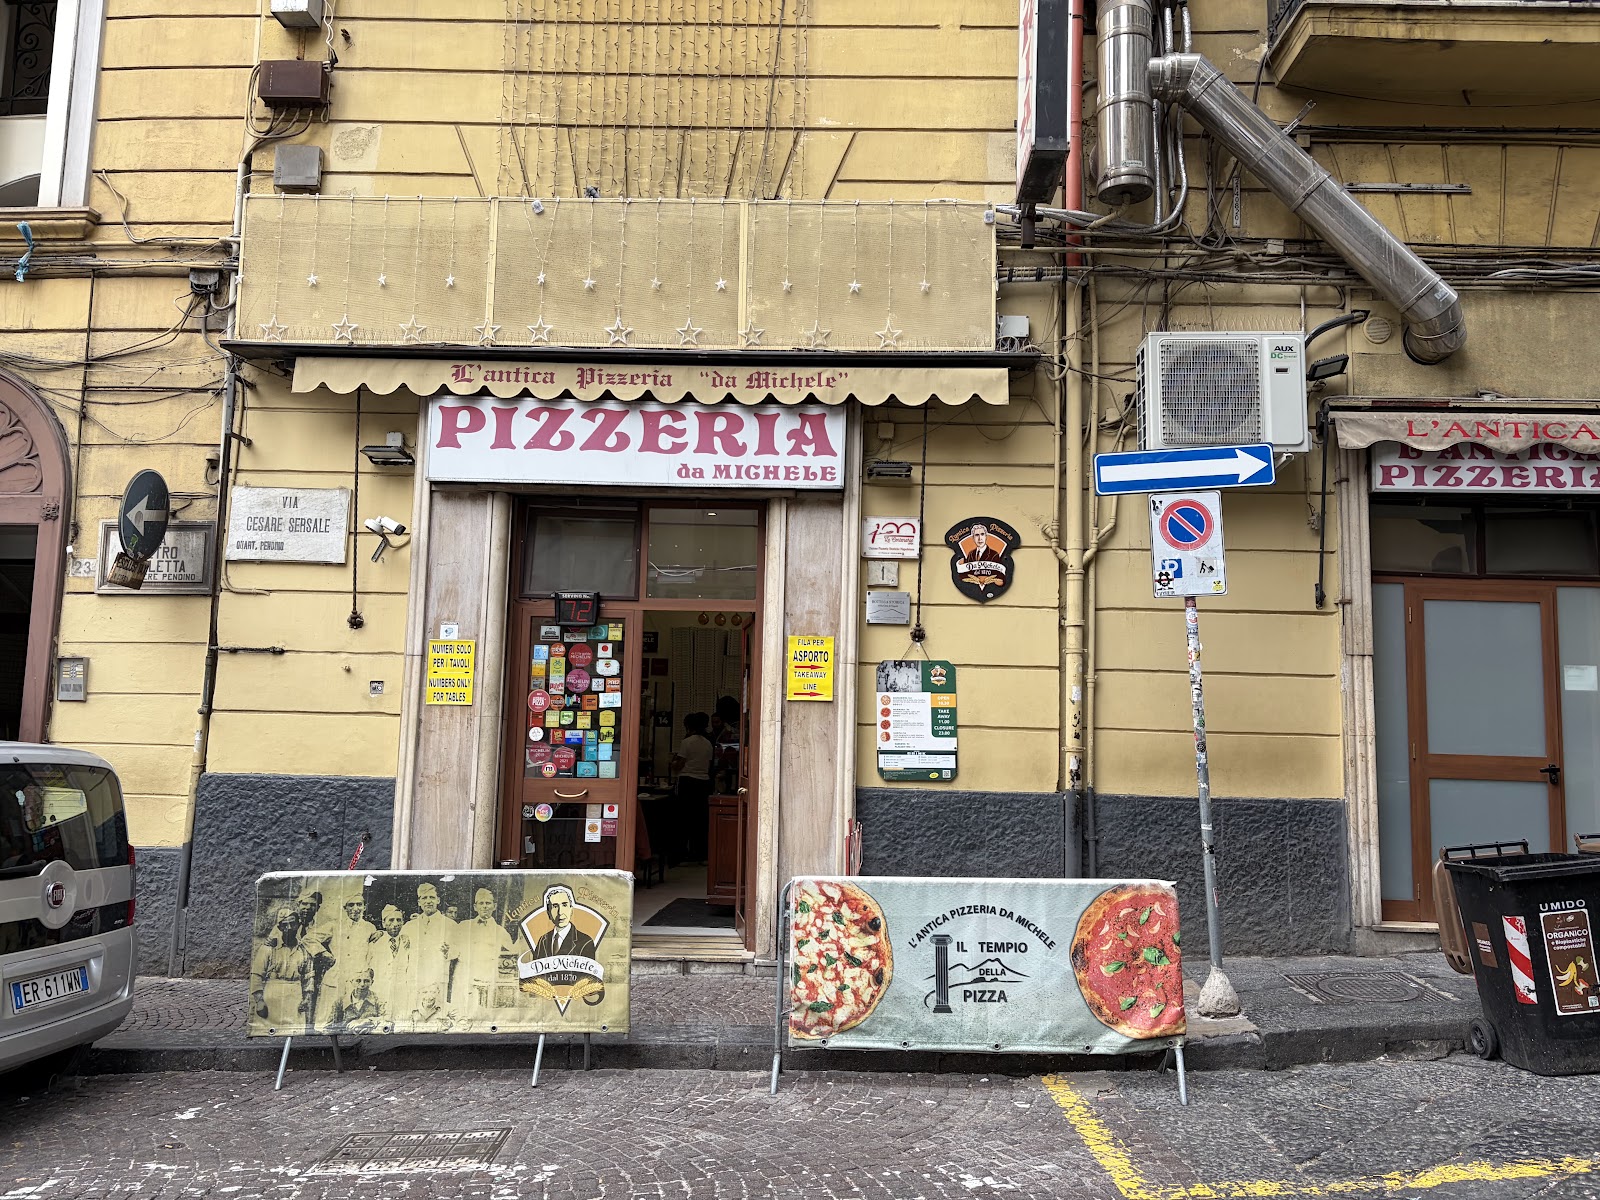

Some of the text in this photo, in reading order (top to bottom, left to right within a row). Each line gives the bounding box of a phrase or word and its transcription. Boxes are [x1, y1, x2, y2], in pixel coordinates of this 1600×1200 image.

[576, 367, 673, 389] Pizzeria
[435, 405, 838, 458] PIZZERIA
[1407, 420, 1600, 440] L'ANTICA
[676, 463, 837, 482] da MICHELE
[282, 496, 298, 508] VIA
[246, 516, 331, 533] CESARE SERSALE
[73, 560, 91, 574] 23
[881, 565, 885, 580] 1
[162, 573, 196, 581] PENDINO
[565, 600, 593, 622] 72
[431, 644, 472, 654] NUMERI SOLO
[793, 650, 829, 662] ASPORTO
[432, 658, 445, 668] PER
[449, 658, 470, 668] TAVOLI
[428, 678, 471, 688] NUMBERS ONLY
[432, 692, 466, 702] FOR TABLES
[576, 886, 620, 919] Pizzeria
[1539, 899, 1586, 911] UMIDO
[949, 904, 997, 919] PIZZERIA
[999, 907, 1014, 921] DA
[1015, 914, 1057, 950] MICHELE
[1546, 928, 1588, 940] ORGANICO
[956, 941, 1028, 953] IL TEMPIO
[530, 956, 595, 974] Da Michele
[979, 968, 1006, 976] DELLA
[560, 973, 577, 981] 1870
[22, 970, 81, 1004] ER 611WN
[963, 989, 1008, 1003] PIZZA
